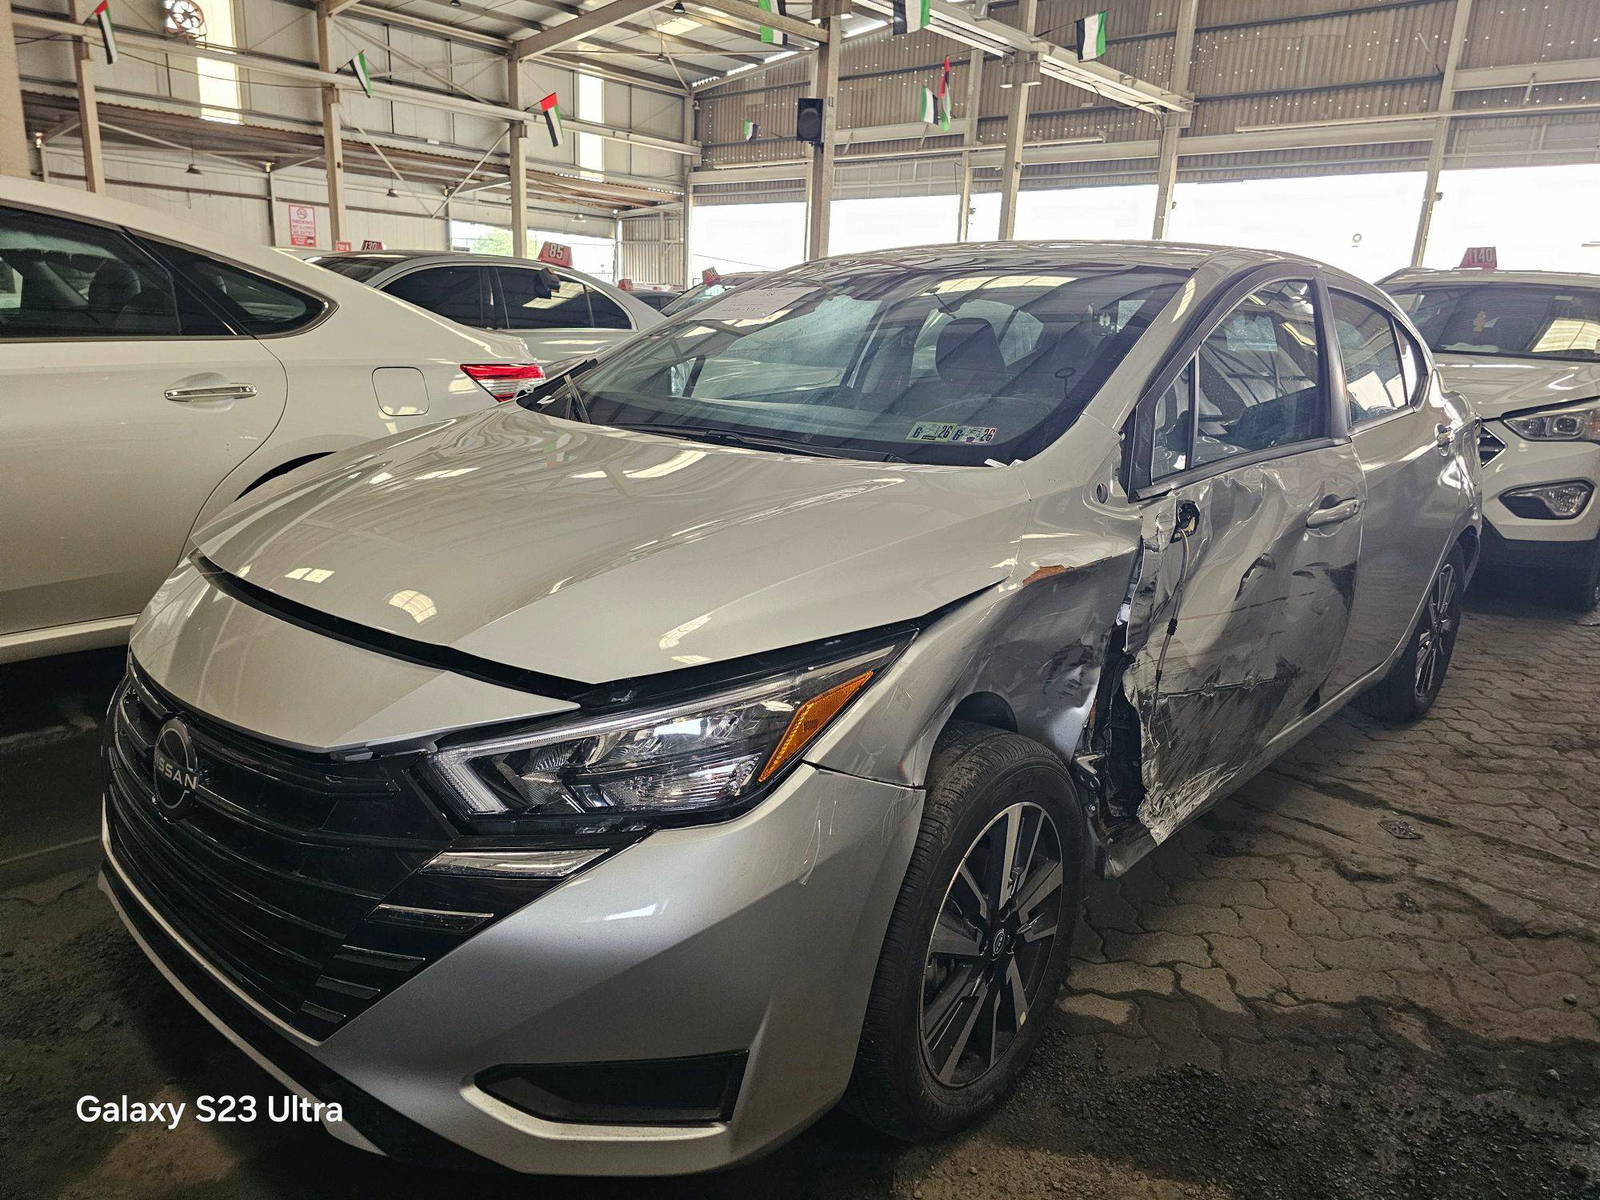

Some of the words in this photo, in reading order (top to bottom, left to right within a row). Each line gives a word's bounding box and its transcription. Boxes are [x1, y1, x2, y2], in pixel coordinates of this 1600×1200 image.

[549, 243, 564, 259] 85
[1473, 248, 1493, 262] 140
[937, 425, 953, 439] 26
[980, 428, 996, 442] 26
